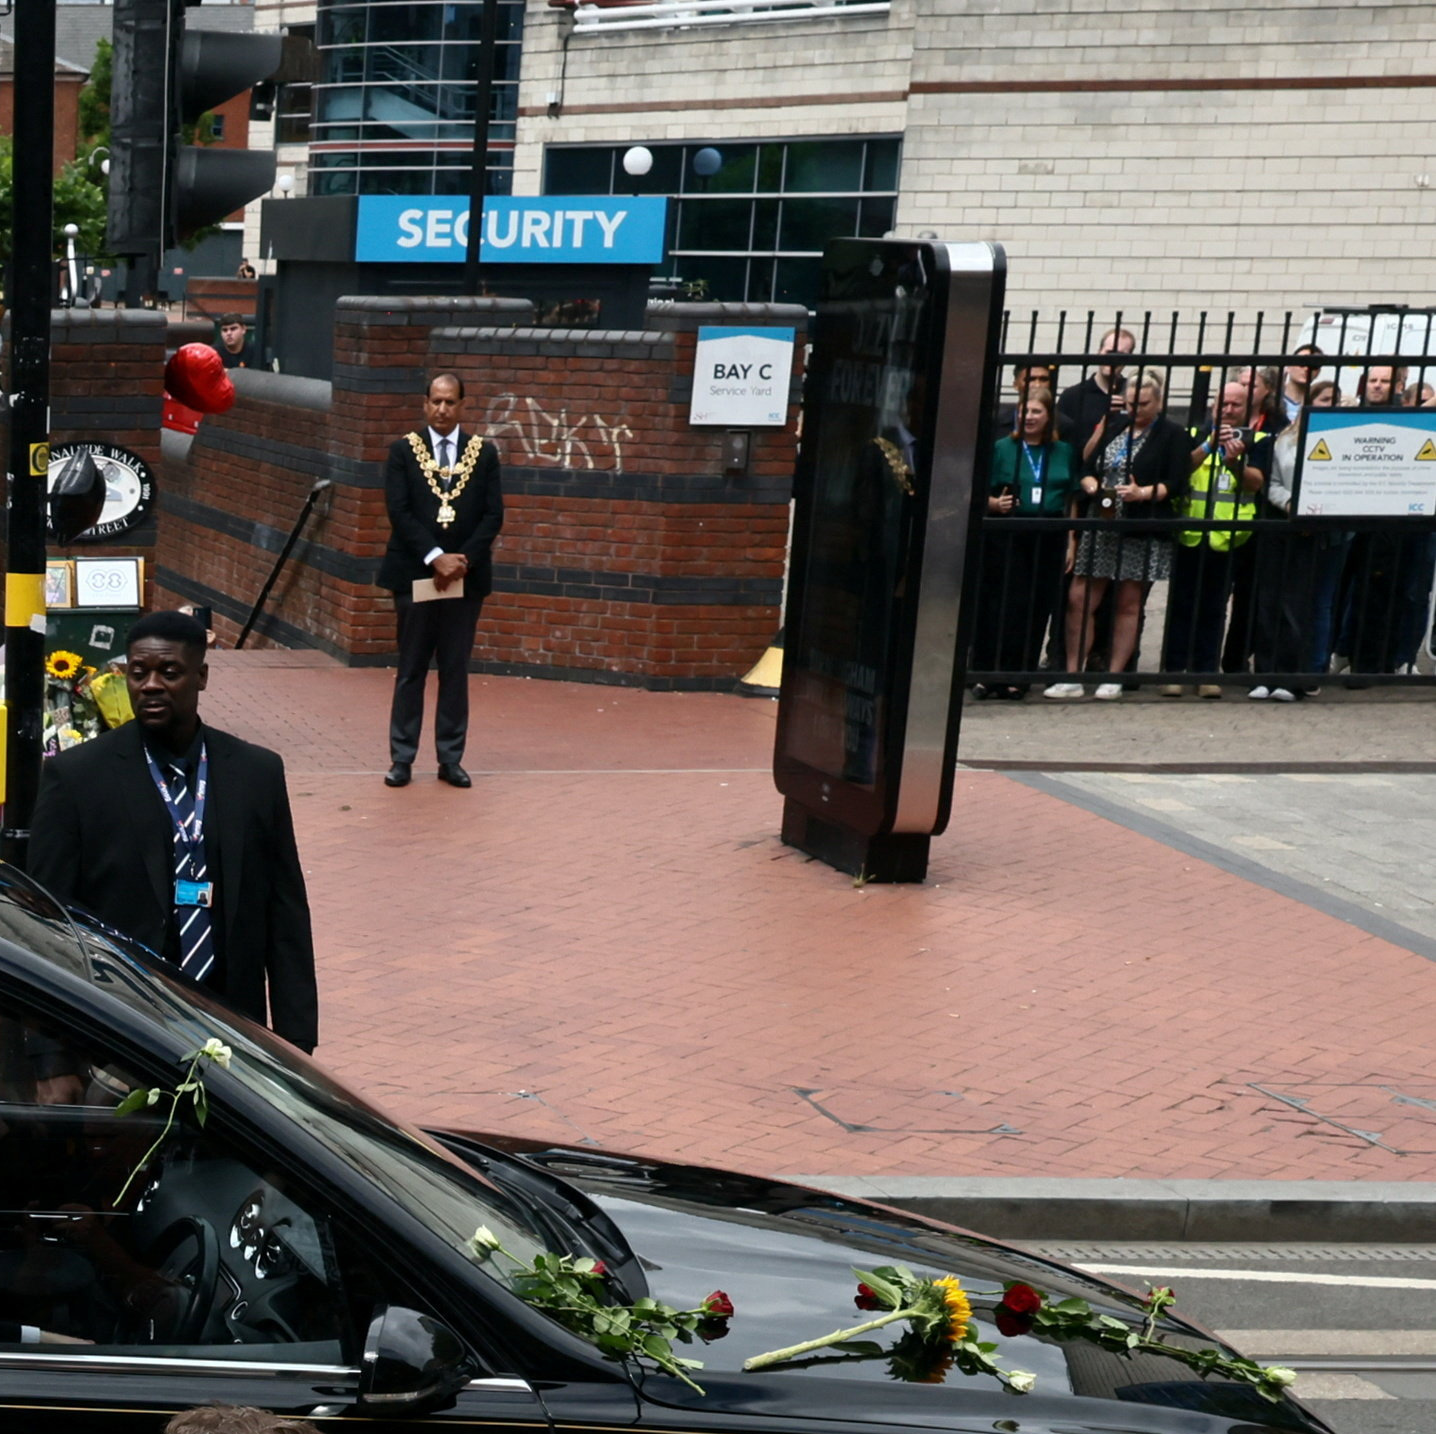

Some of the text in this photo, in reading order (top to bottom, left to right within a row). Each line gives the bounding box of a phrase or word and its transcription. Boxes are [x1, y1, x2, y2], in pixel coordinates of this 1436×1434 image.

[713, 363, 773, 380] BAY C
[710, 385, 772, 397] Service Yard
[1353, 437, 1397, 445] WARNING
[110, 447, 144, 474] WALK
[1342, 454, 1404, 462] IN OPERATION
[1408, 503, 1425, 512] ICC
[90, 517, 130, 535] TREET
